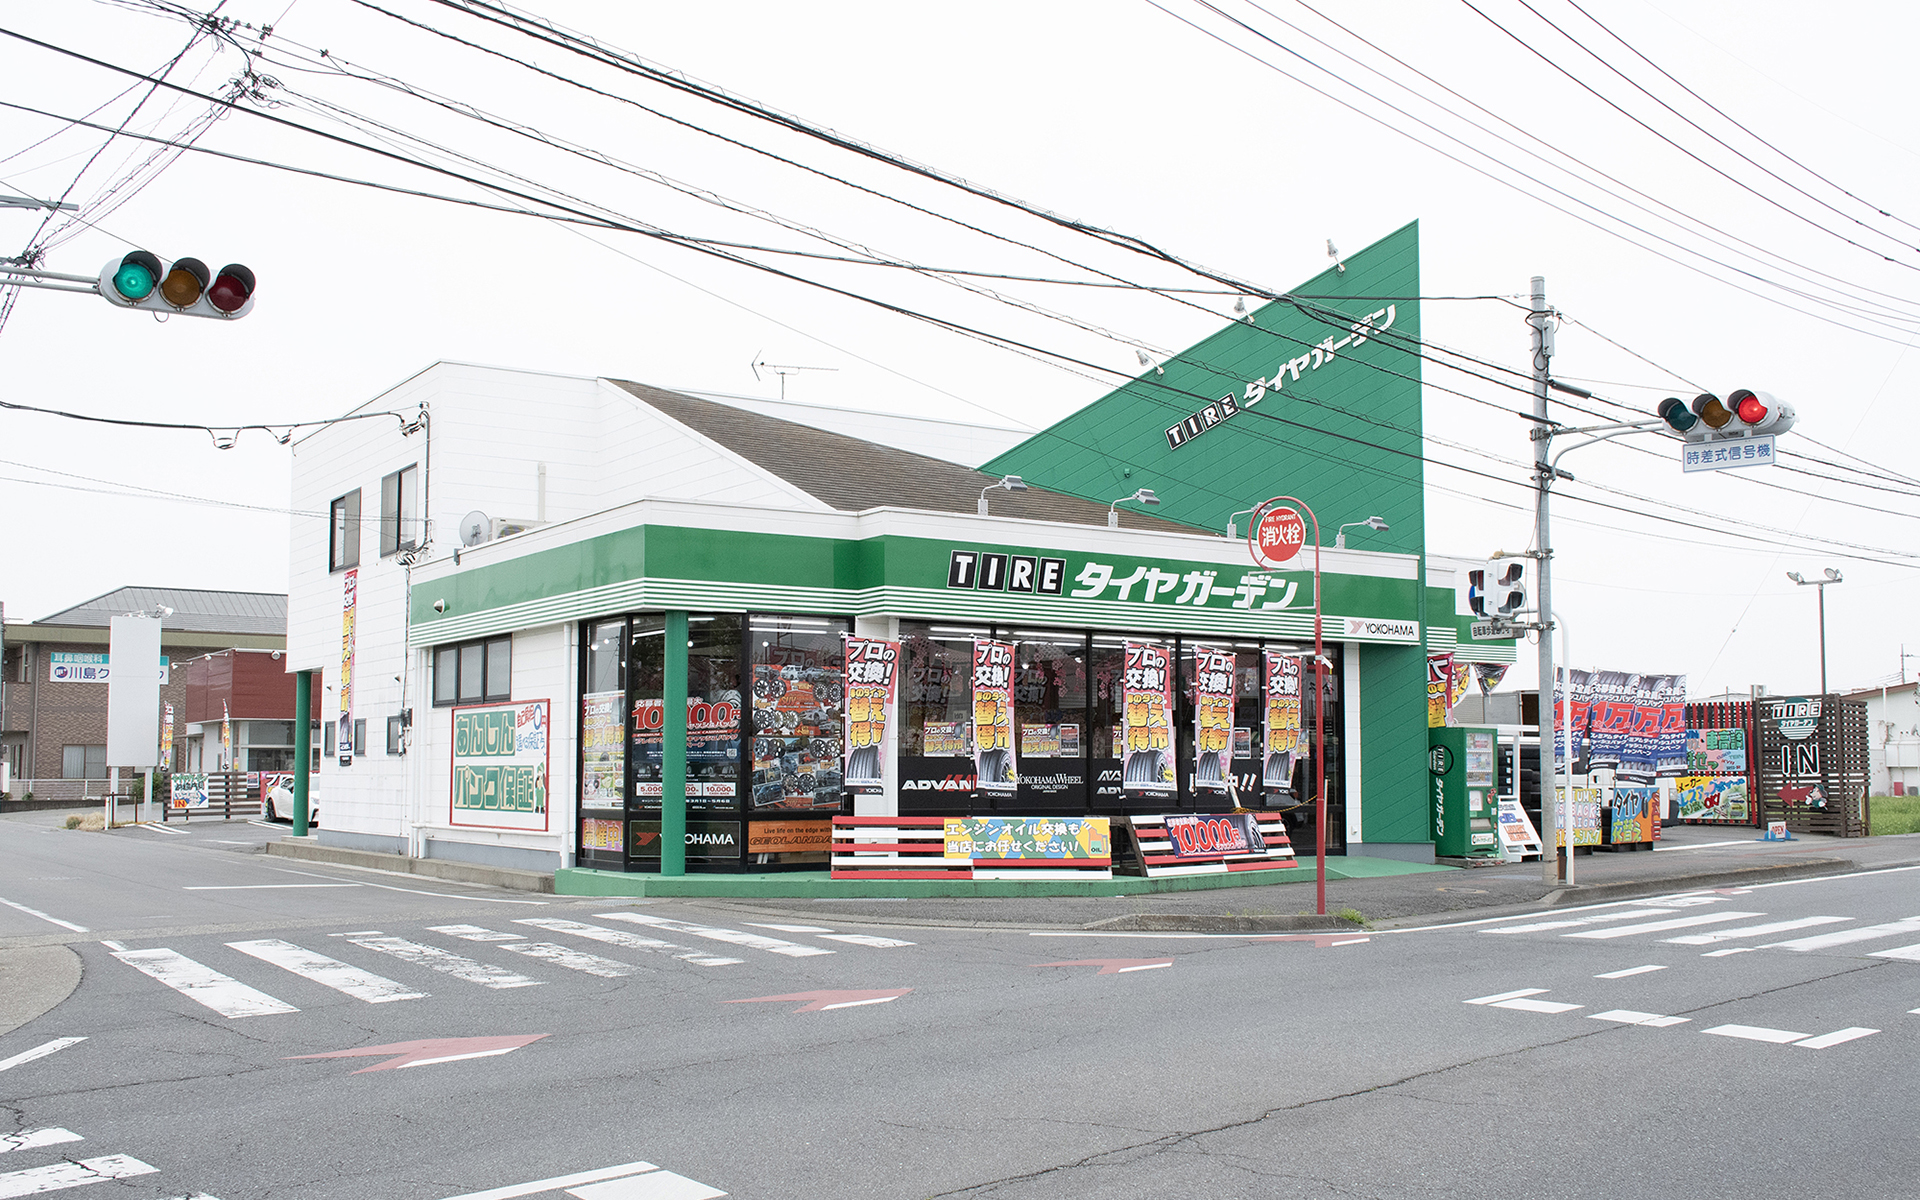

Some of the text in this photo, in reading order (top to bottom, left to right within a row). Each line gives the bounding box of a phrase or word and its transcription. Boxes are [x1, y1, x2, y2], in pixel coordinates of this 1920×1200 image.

[1167, 304, 1396, 449] TIRE タイヤガーデン
[1686, 444, 1771, 465] 時差式信号機
[1262, 523, 1301, 547] 消火栓
[950, 552, 1298, 609] TIRE タイヤガーデン
[1364, 622, 1414, 637] YOKOHAMA
[848, 639, 896, 661] プロの
[976, 642, 1011, 665] プロの
[1127, 646, 1167, 669] プロの
[847, 661, 894, 685] 交換!
[1198, 652, 1234, 673] プロの
[1269, 656, 1300, 675] プロの
[974, 665, 1011, 689] 交換!
[1125, 668, 1166, 691] 交換!
[1199, 671, 1234, 695] 交換!
[1268, 675, 1300, 696] 交換!
[1774, 702, 1821, 719] TIRE
[456, 713, 515, 756] あんしん
[1128, 726, 1169, 751] 得市
[1781, 744, 1820, 775] IN
[454, 764, 535, 811] パンク保証
[902, 779, 976, 790] ADVAN
[174, 799, 186, 808] IN
[805, 827, 818, 835] edge
[946, 822, 1081, 836] エンジンオイル交換も
[946, 840, 1080, 853] 当店にお任せください!
